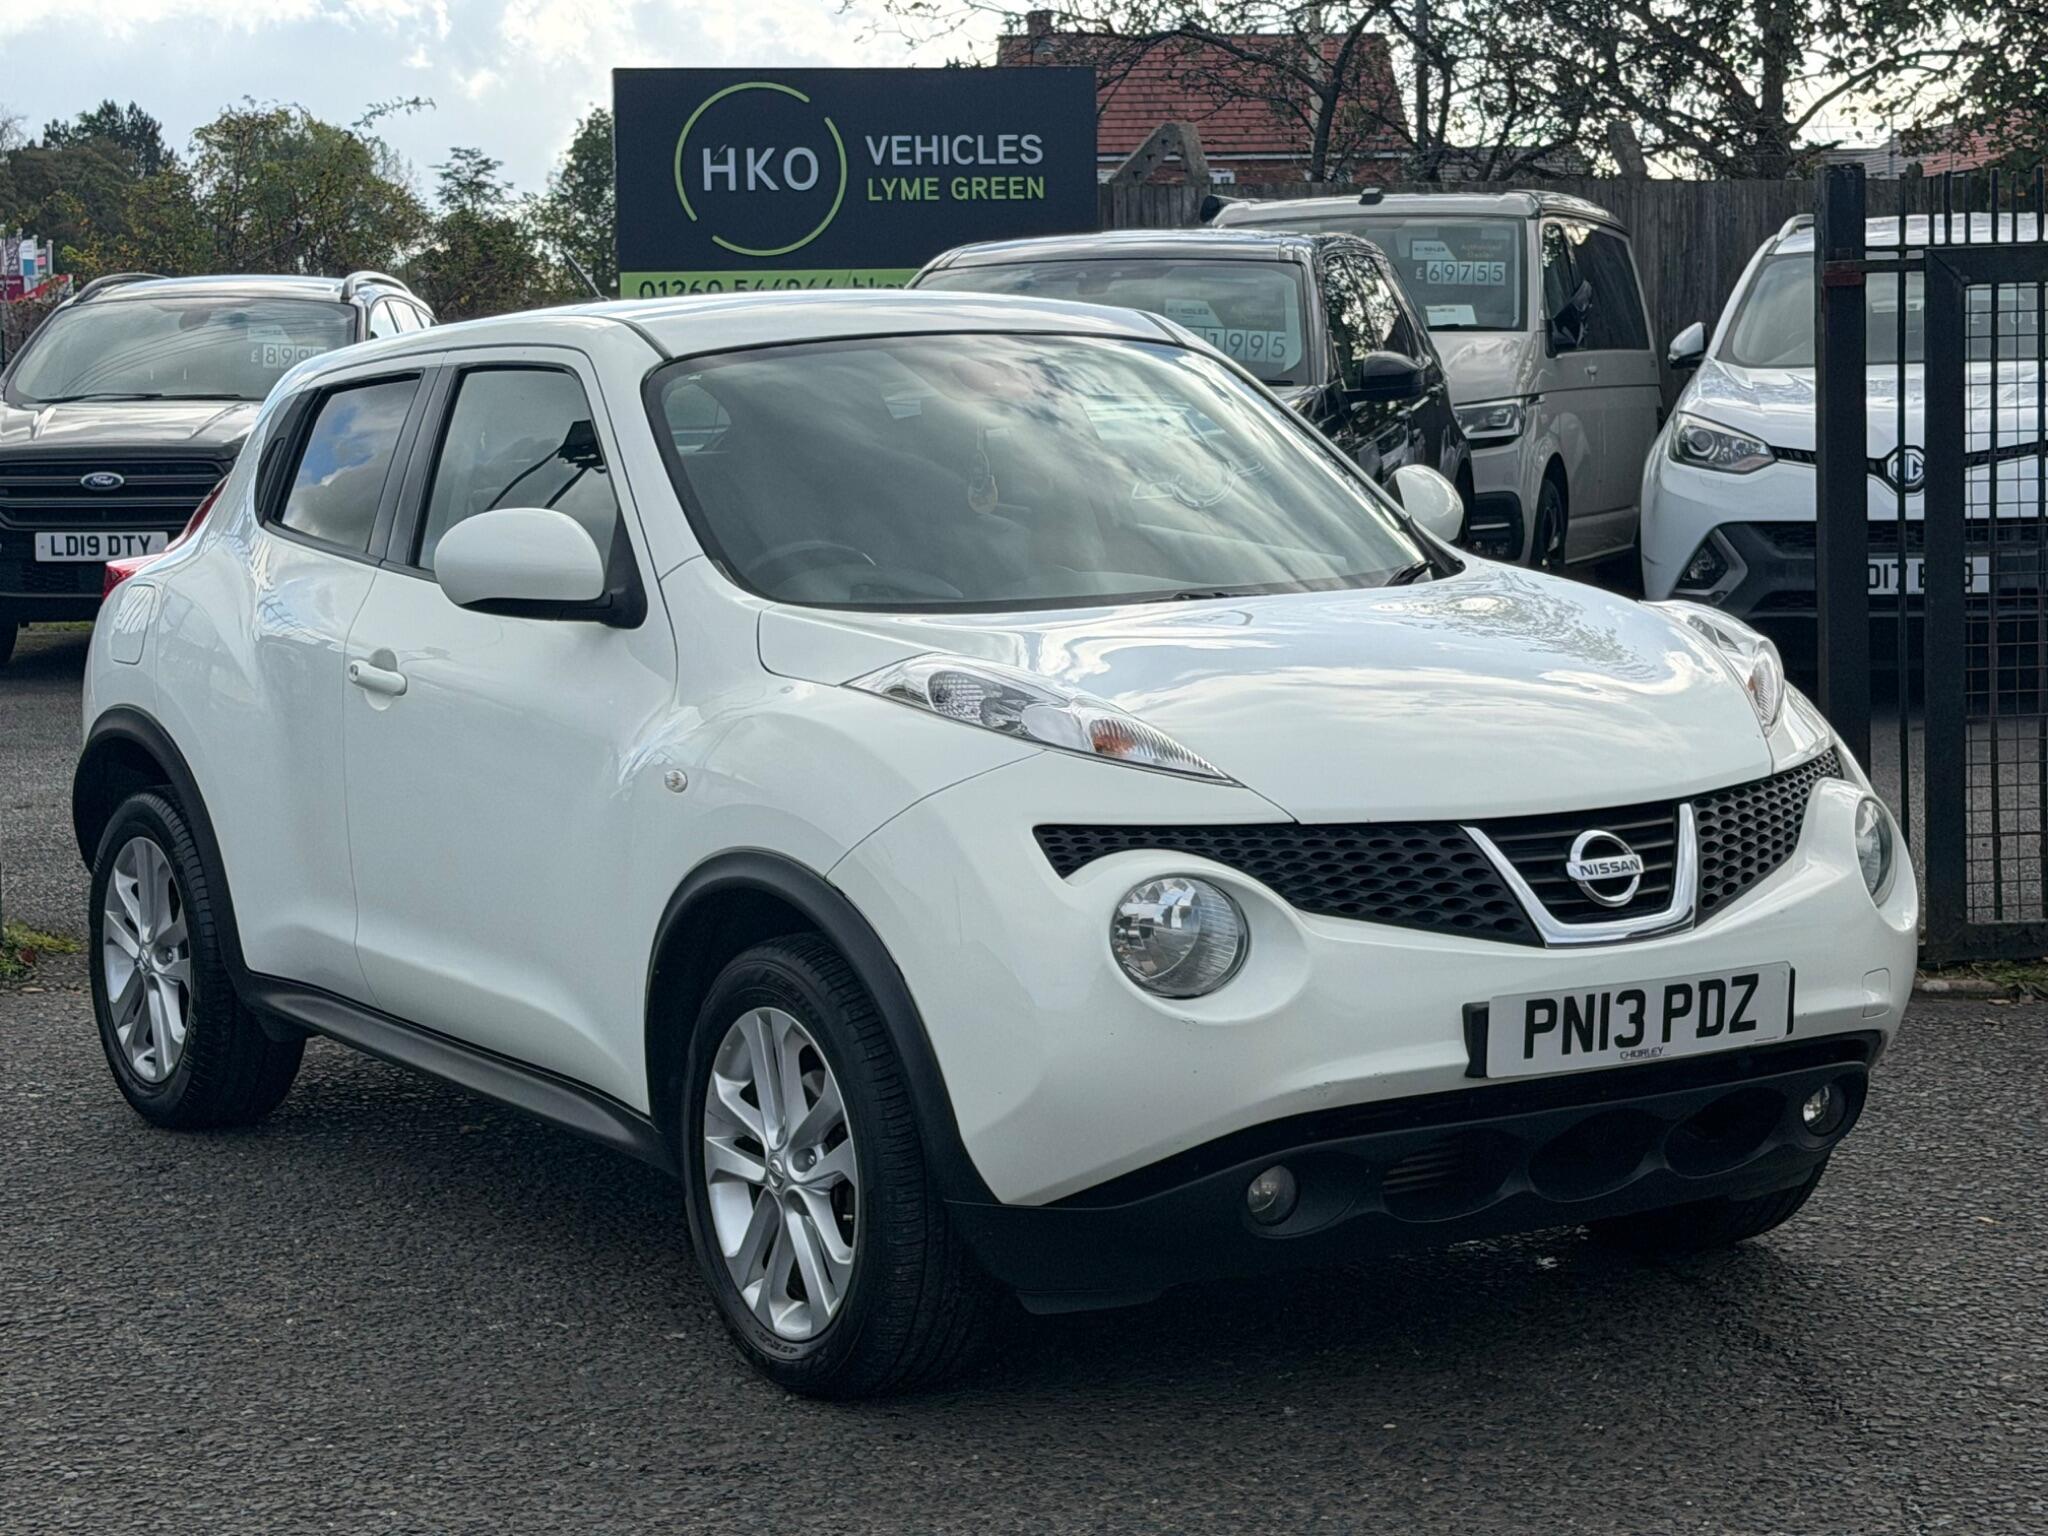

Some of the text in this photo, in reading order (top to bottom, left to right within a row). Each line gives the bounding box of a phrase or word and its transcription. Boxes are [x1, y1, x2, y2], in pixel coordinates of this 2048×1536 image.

[865, 134, 1043, 166] VEHICLES
[702, 147, 819, 191] HKO
[867, 176, 1045, 201] LYME GREEN
[50, 535, 151, 557] LD19 DTY
[1579, 860, 1640, 877] NISSAN
[1523, 973, 1759, 1060] PN13 PDZ
